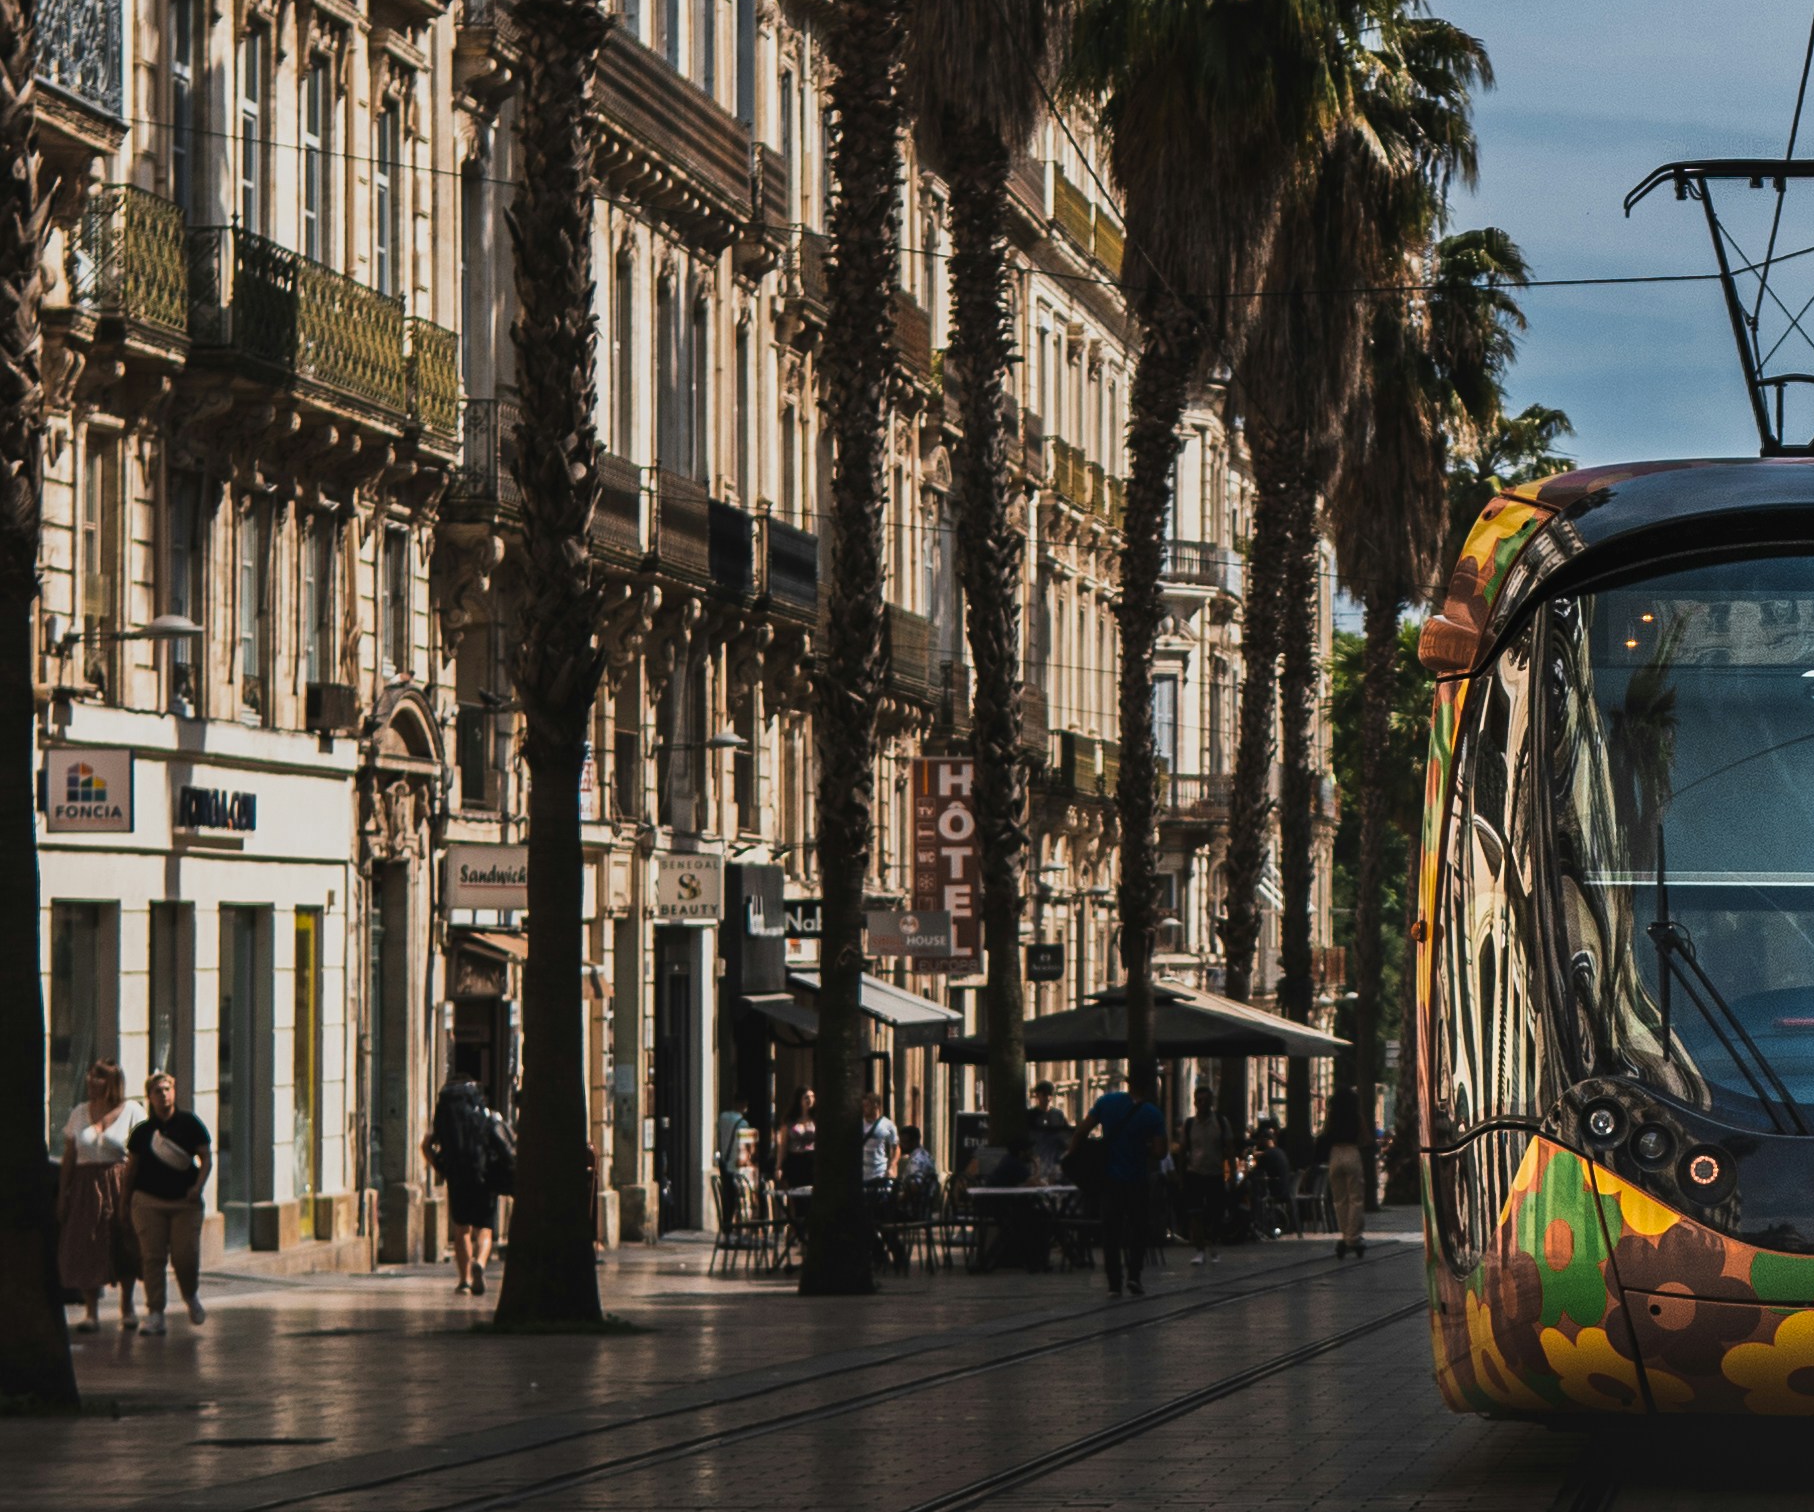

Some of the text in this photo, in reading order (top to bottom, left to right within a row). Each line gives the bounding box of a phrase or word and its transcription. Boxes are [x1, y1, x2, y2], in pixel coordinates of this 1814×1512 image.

[55, 805, 123, 818] FONCIA
[661, 860, 719, 870] SENEGAL
[938, 763, 976, 956] HÔTEL
[661, 904, 719, 915] BEAUTY
[906, 935, 947, 946] HOUSE
